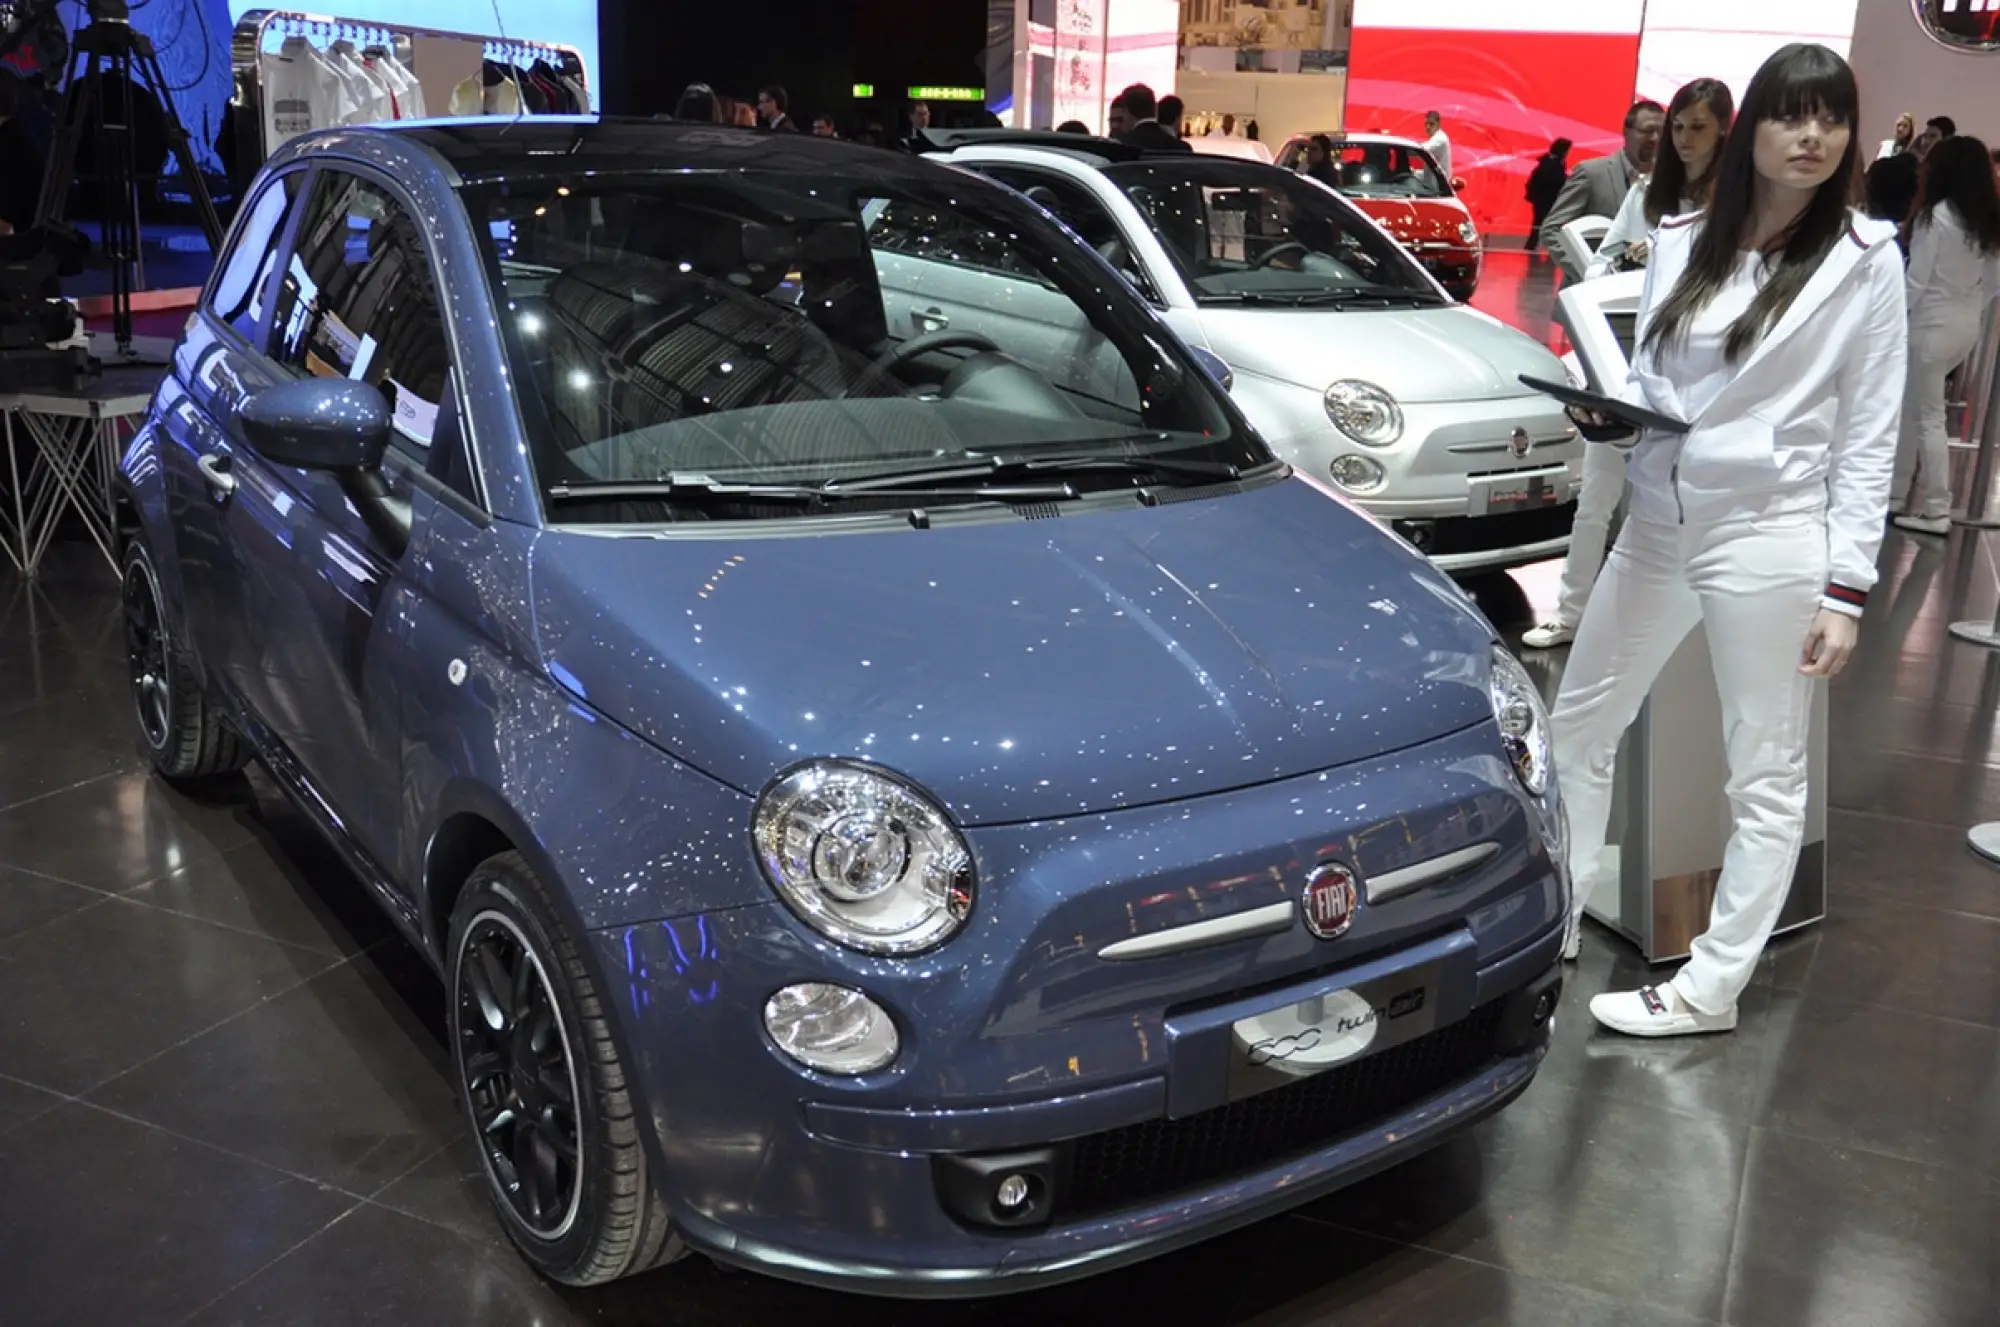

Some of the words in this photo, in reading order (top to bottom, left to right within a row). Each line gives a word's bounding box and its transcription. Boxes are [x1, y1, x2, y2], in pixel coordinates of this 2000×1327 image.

[1316, 882, 1346, 920] FIAT
[1247, 1028, 1322, 1067] 500
[1337, 1007, 1386, 1034] twin
